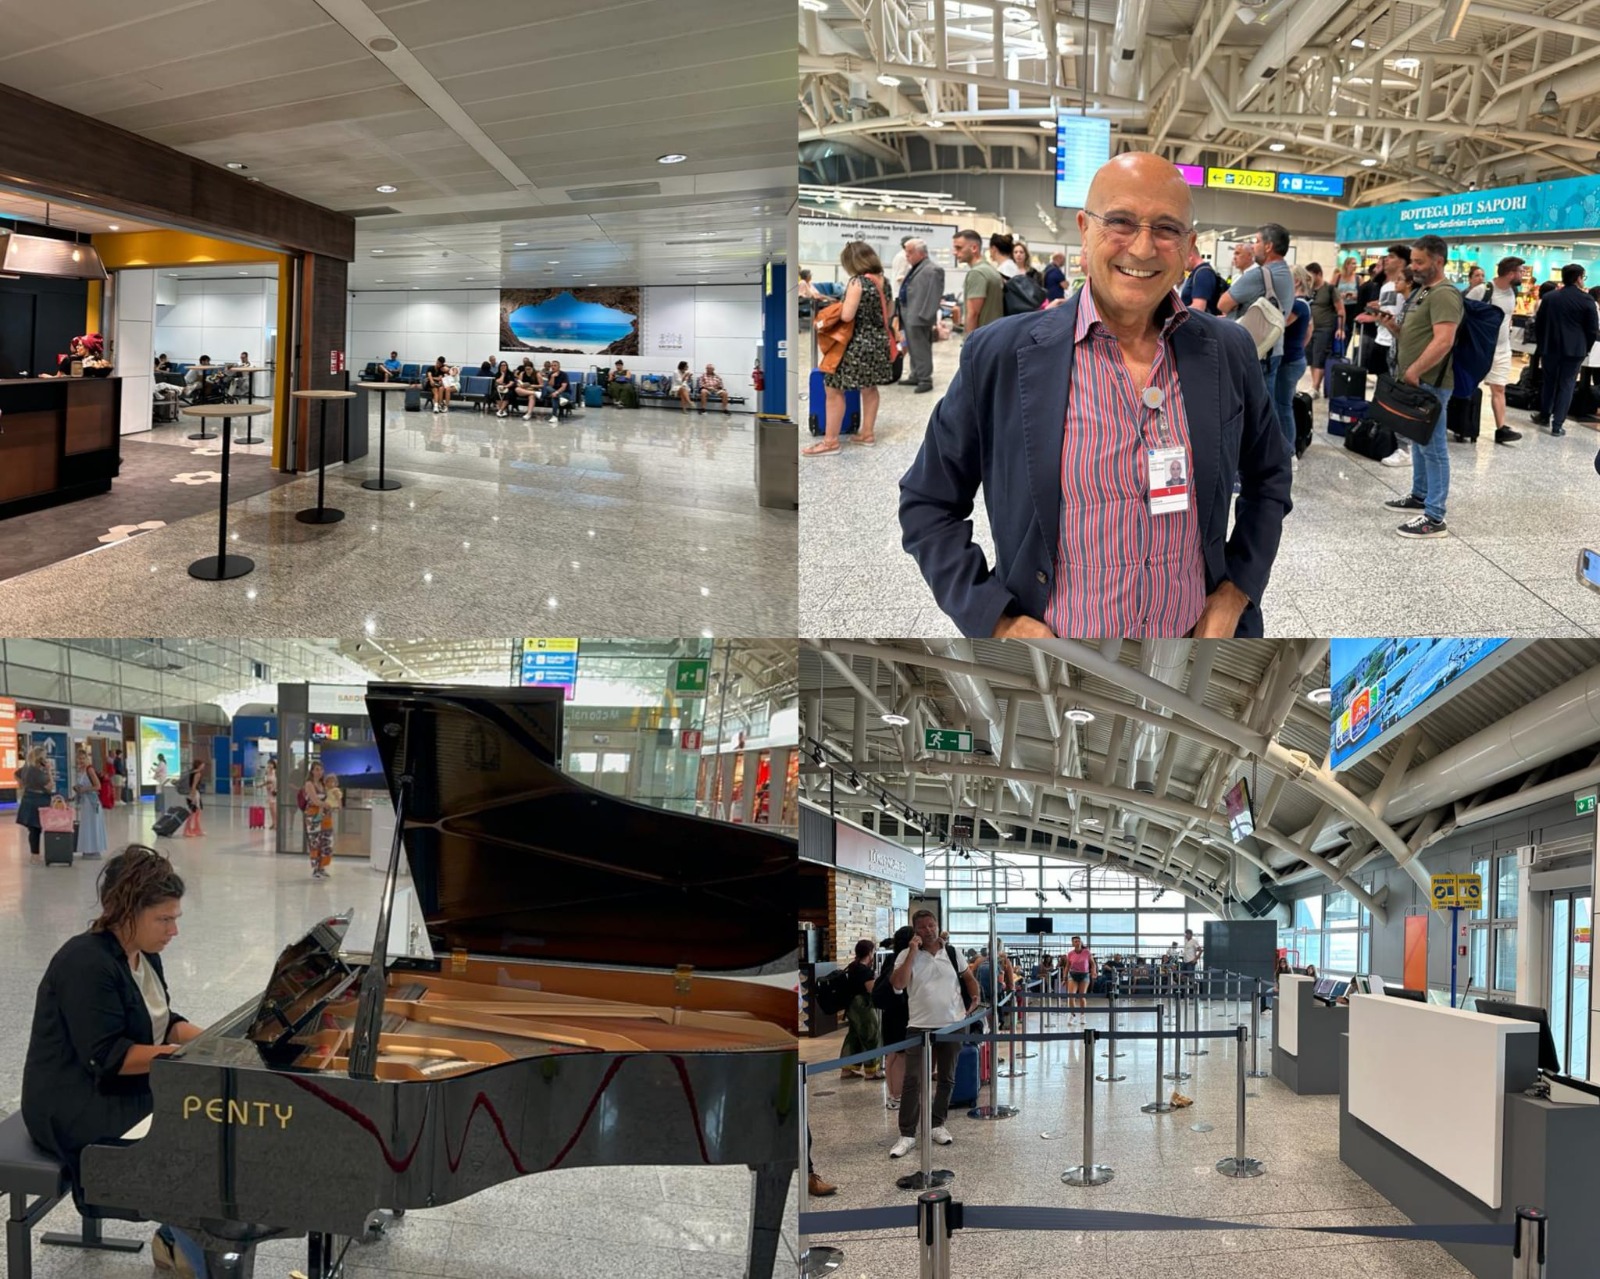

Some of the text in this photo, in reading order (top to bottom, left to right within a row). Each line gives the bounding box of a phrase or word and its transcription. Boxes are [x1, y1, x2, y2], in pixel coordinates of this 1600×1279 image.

[1238, 174, 1271, 188] 20-23
[1400, 195, 1527, 221] BOTTEGA DEI SAPORI
[860, 222, 891, 231] exclusive
[892, 224, 913, 232] brand
[1467, 217, 1505, 228] Experience
[263, 721, 270, 734] 1
[183, 1095, 293, 1129] PENTY
